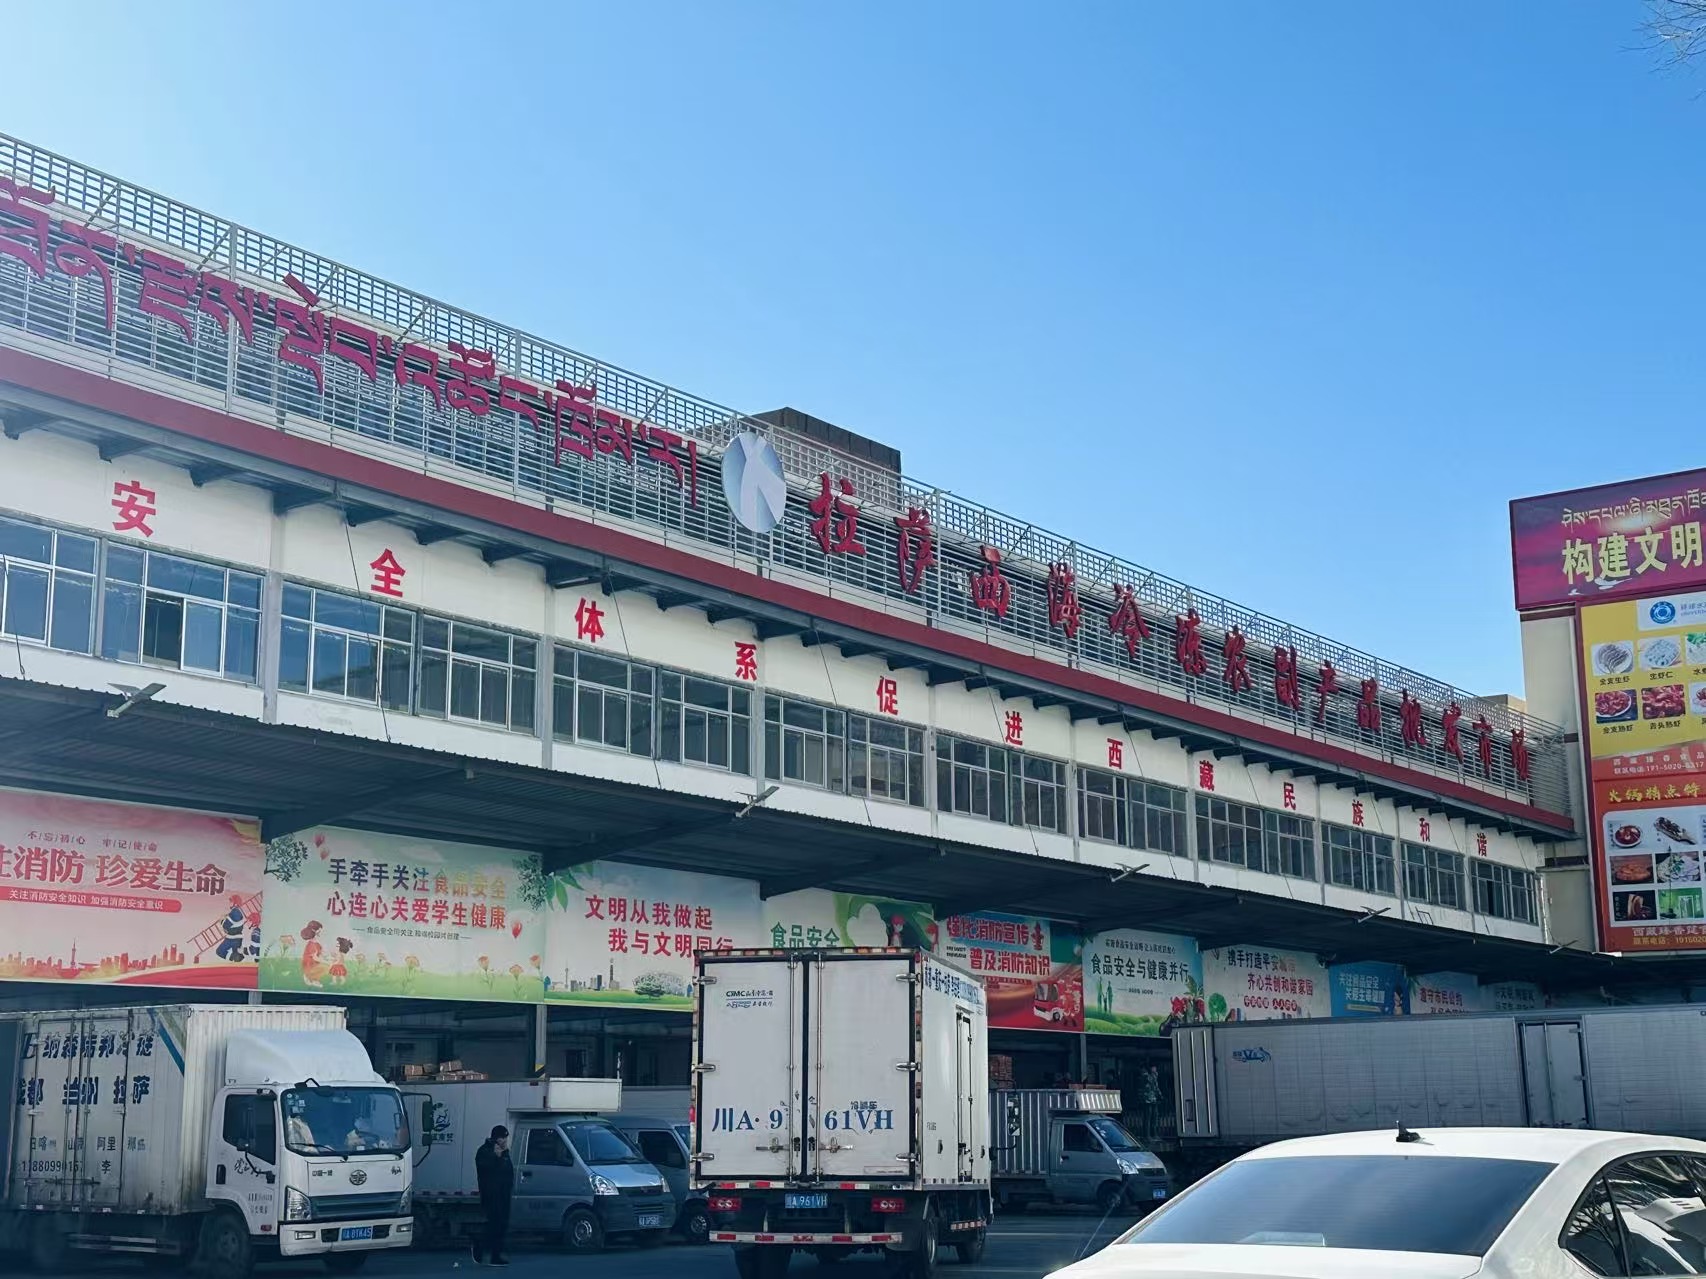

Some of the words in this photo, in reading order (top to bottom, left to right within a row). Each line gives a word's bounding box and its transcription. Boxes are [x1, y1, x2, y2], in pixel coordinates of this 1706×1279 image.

[1562, 521, 1703, 584] 构建文明
[95, 854, 227, 896] 珍爱生命
[9, 889, 87, 904] 关注消防安全知识
[327, 890, 507, 930] 心连心关爱学生健康
[585, 894, 713, 930] 文明从我做起
[607, 928, 733, 958] 我与文明同行
[771, 922, 840, 948] 食品安全
[969, 947, 1050, 977] 普及消防知识
[1091, 953, 1189, 982] 食品安全与健康并行
[62, 1076, 99, 1105] 兰州
[113, 1075, 150, 1105] 拉萨
[97, 1136, 116, 1151] 阿里
[101, 1160, 111, 1174] 李
